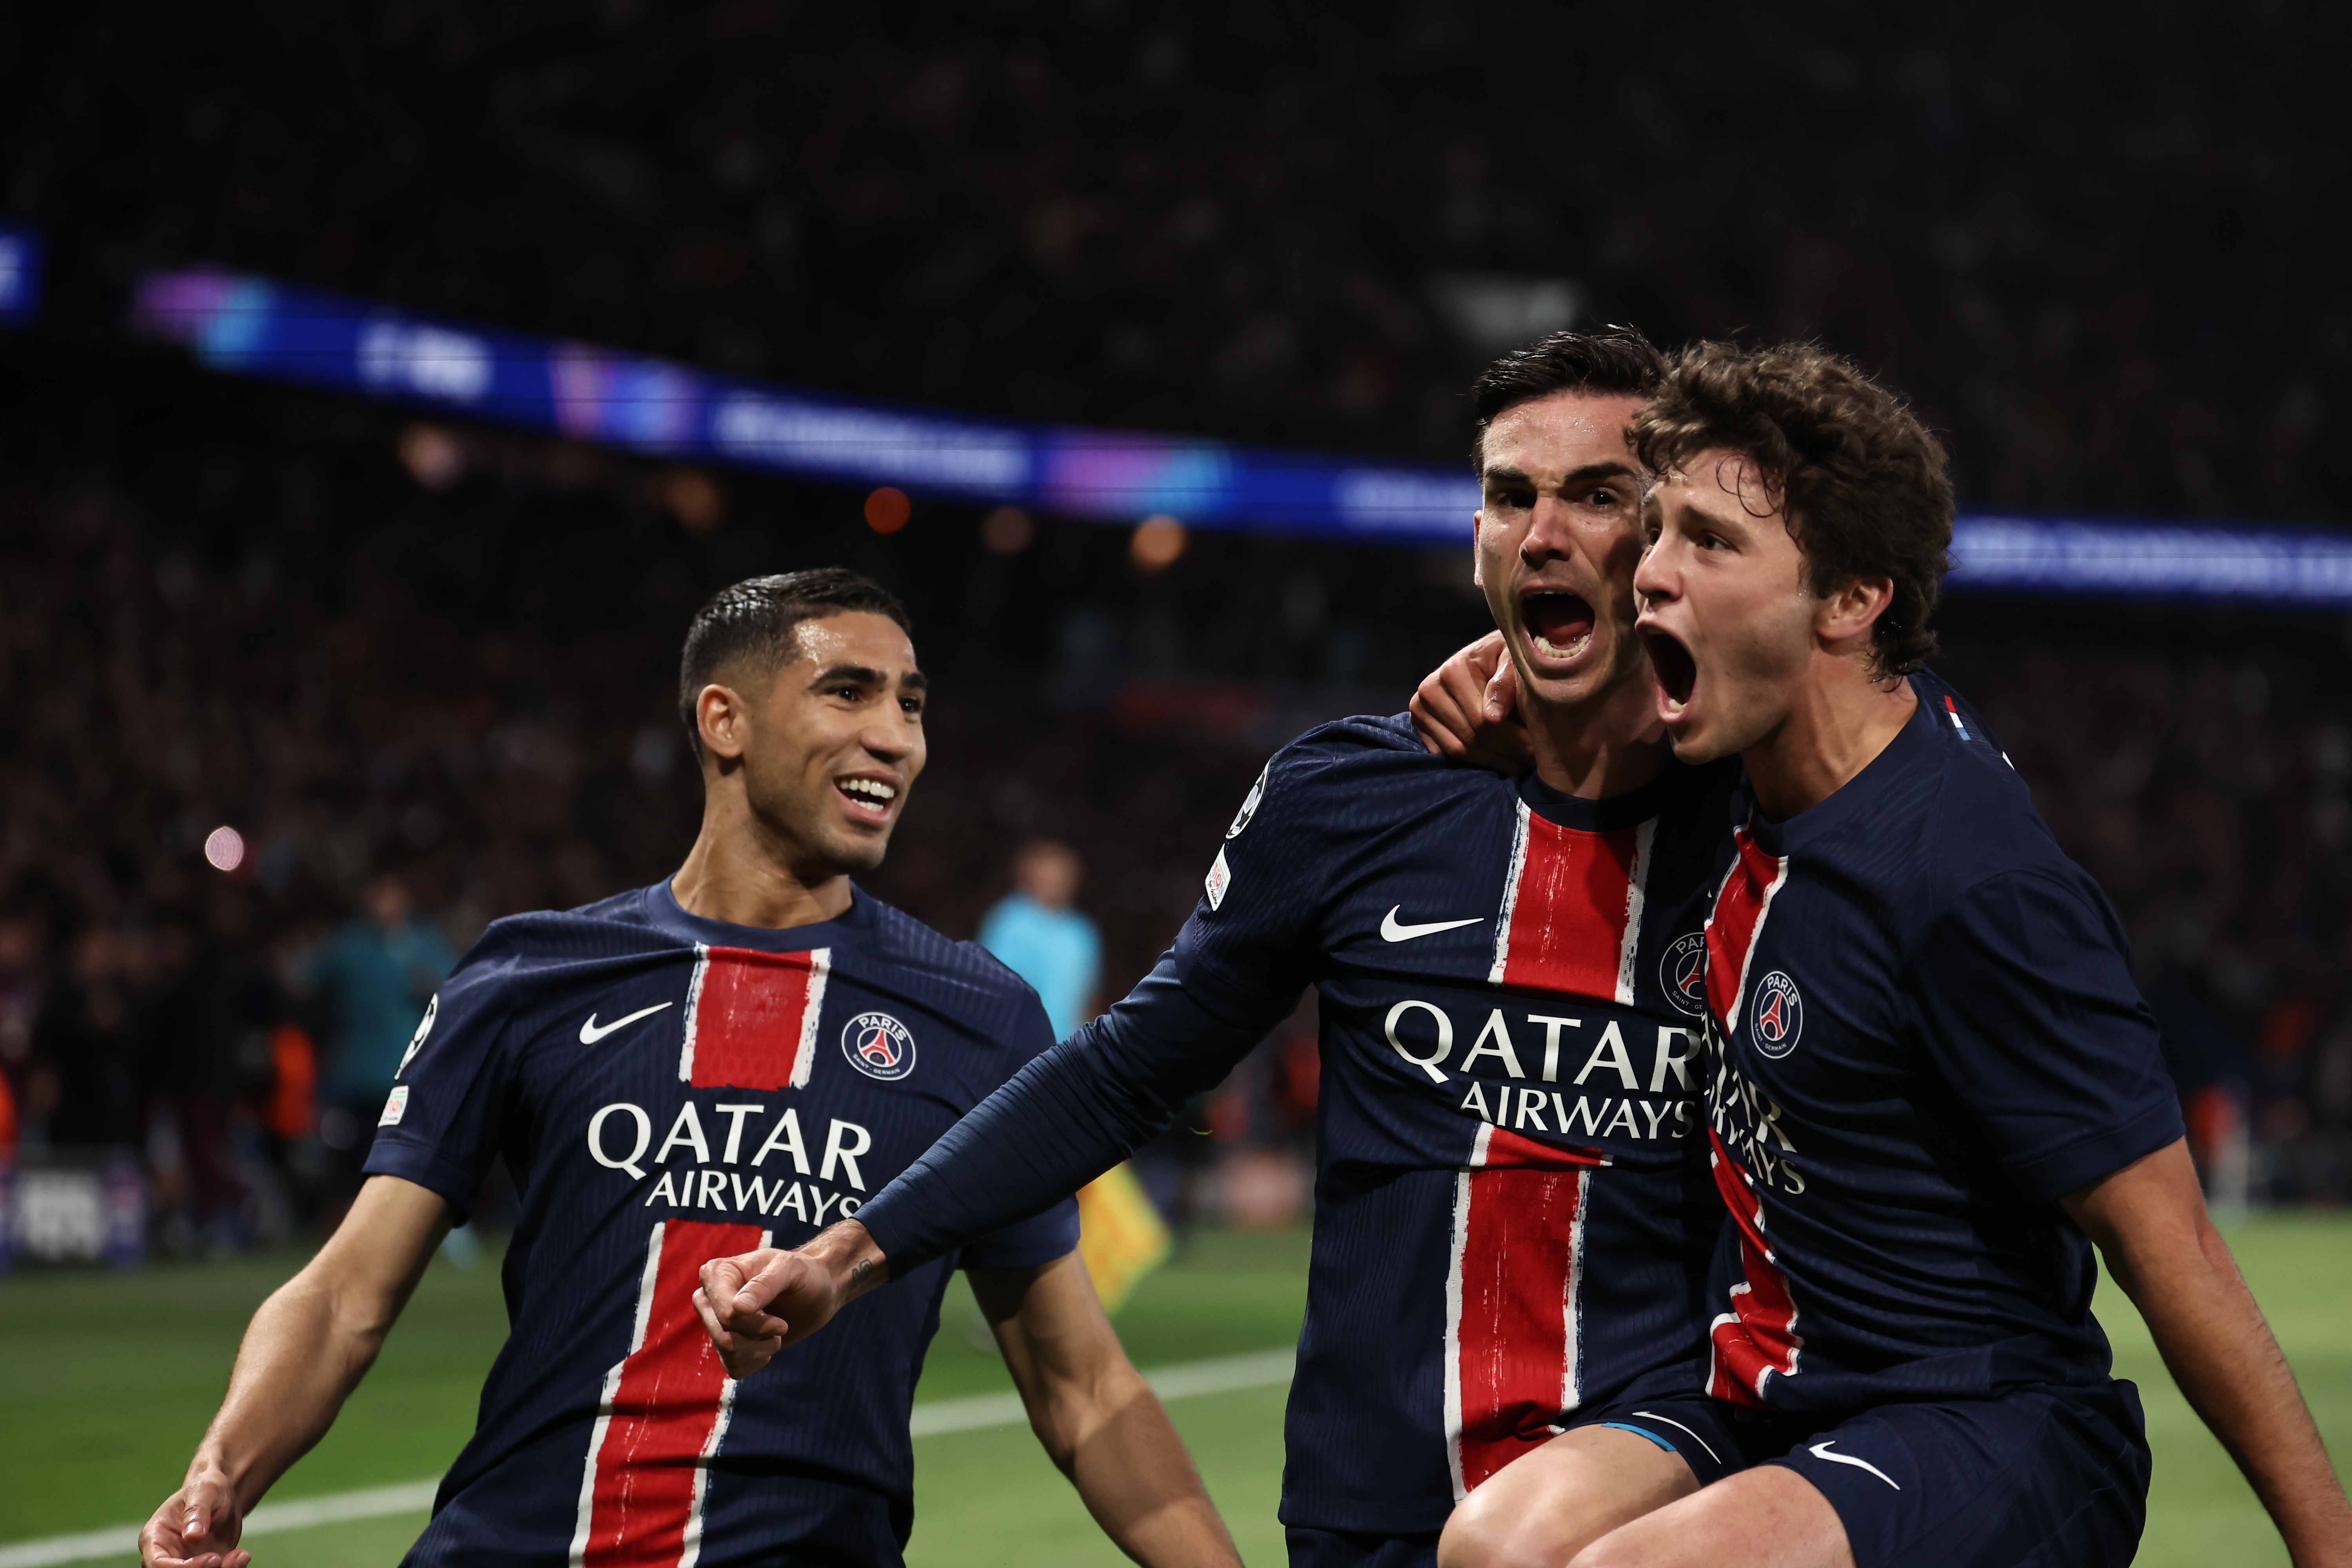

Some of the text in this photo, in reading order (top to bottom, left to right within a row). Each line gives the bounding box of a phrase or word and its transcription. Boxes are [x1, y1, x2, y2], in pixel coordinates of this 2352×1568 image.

[1672, 990, 1690, 1006] SAINT
[1767, 975, 1798, 1006] PARIS
[858, 1015, 907, 1041] PARIS
[1384, 1000, 1701, 1093] QATAR
[1765, 1042, 1787, 1051] GERMAIN
[1459, 1081, 1696, 1139] AIRWAYS
[587, 1100, 872, 1192] QATAR
